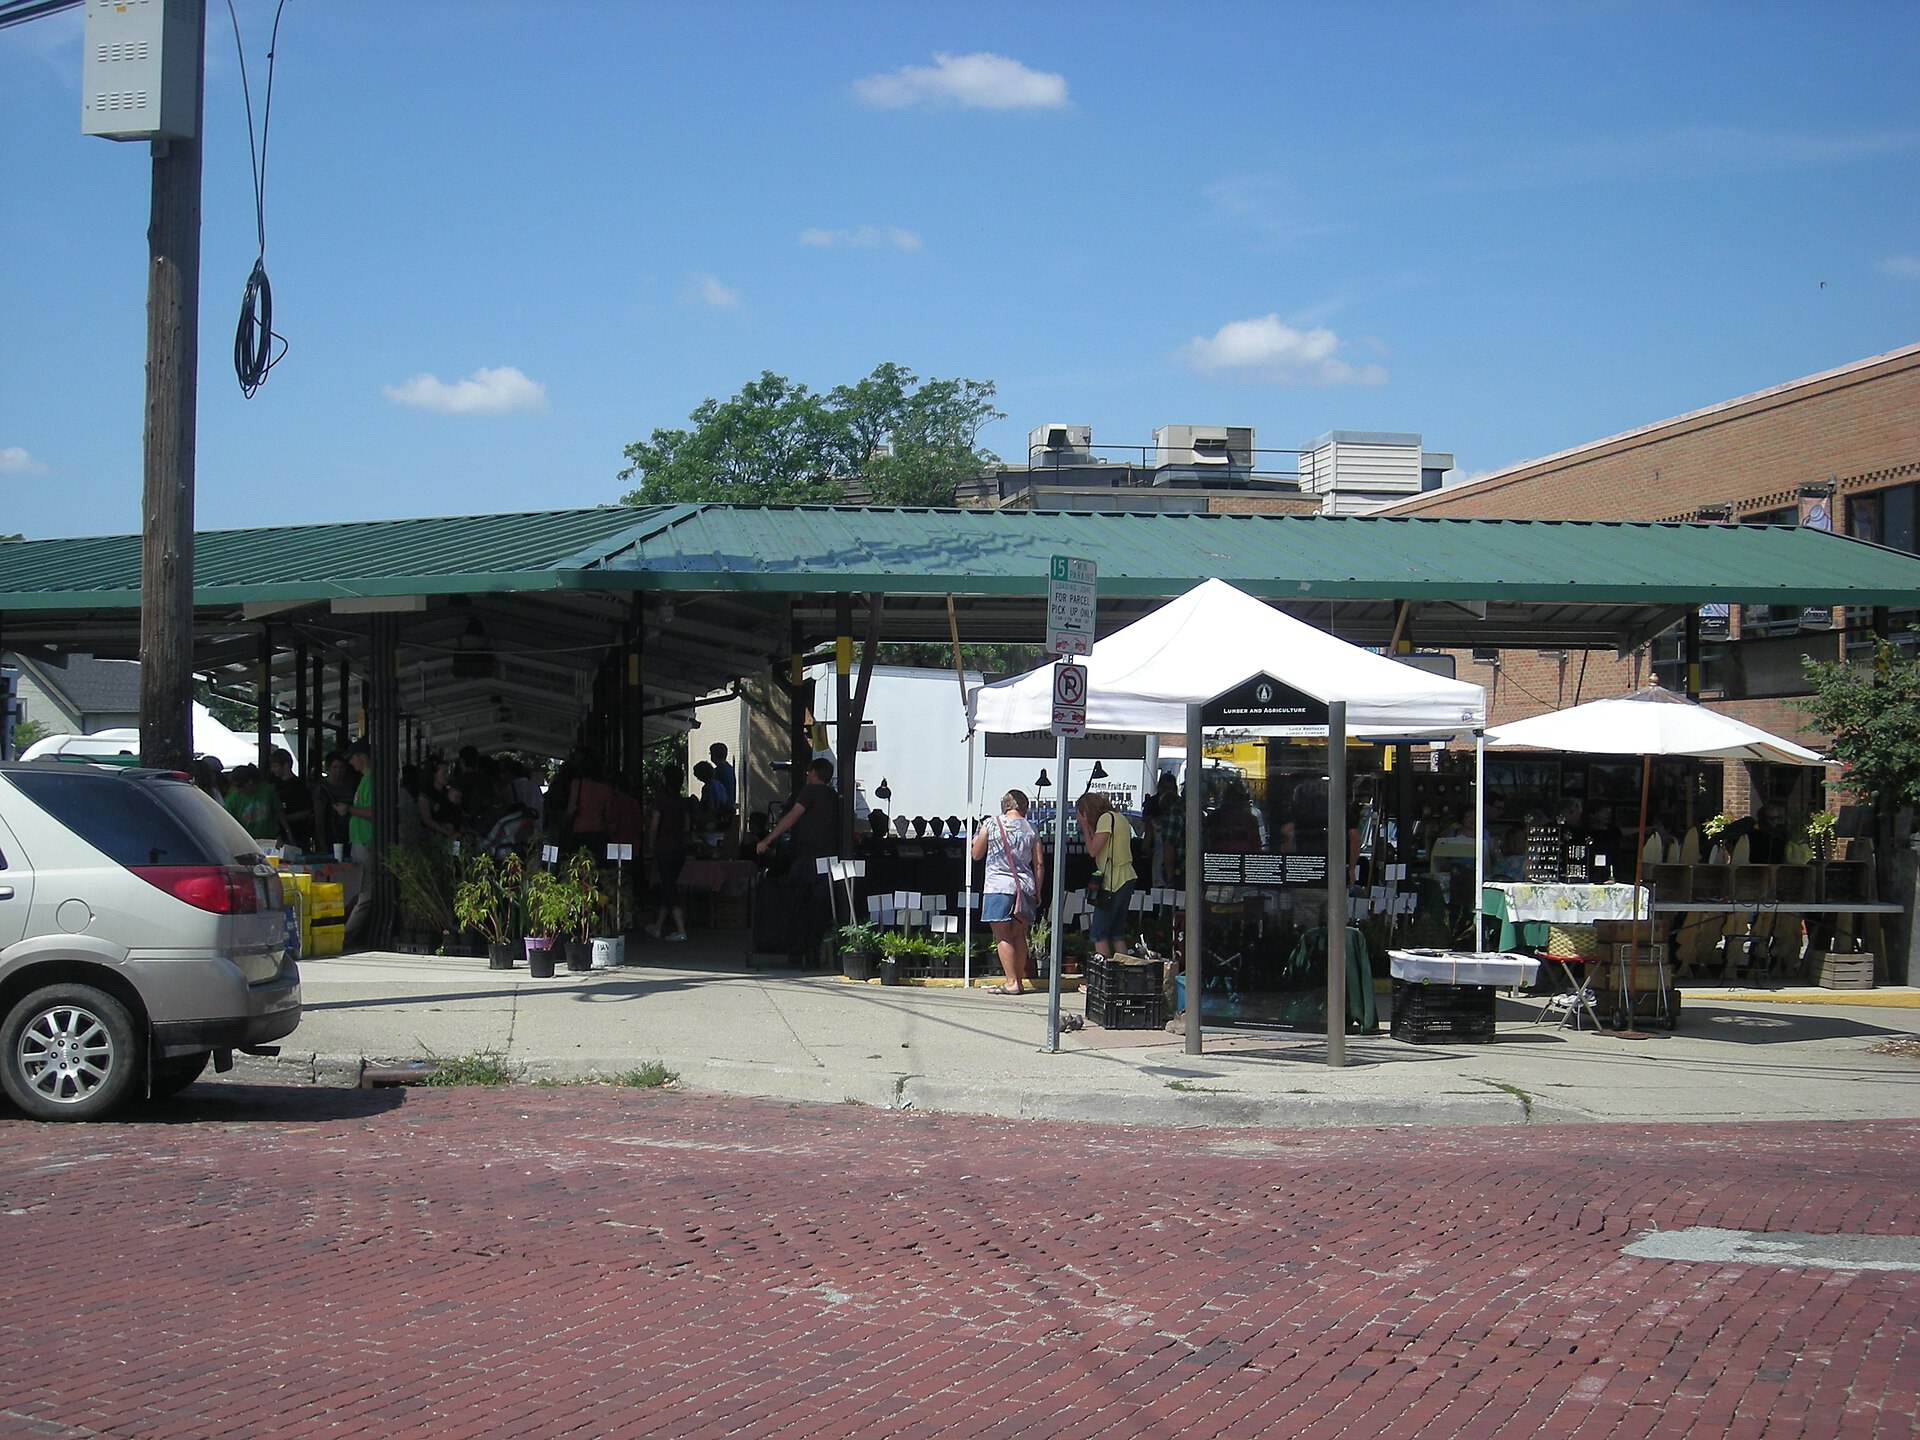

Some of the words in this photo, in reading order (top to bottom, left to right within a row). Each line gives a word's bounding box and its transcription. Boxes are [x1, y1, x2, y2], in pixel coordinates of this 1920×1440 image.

[1053, 558, 1065, 577] 15
[1055, 592, 1067, 603] FOR
[1069, 594, 1090, 606] PARCEL
[1052, 604, 1066, 614] PICK
[1070, 607, 1078, 616] UP
[1080, 608, 1094, 618] ONLY
[1108, 782, 1121, 790] Fruit
[1123, 783, 1137, 791] Farm
